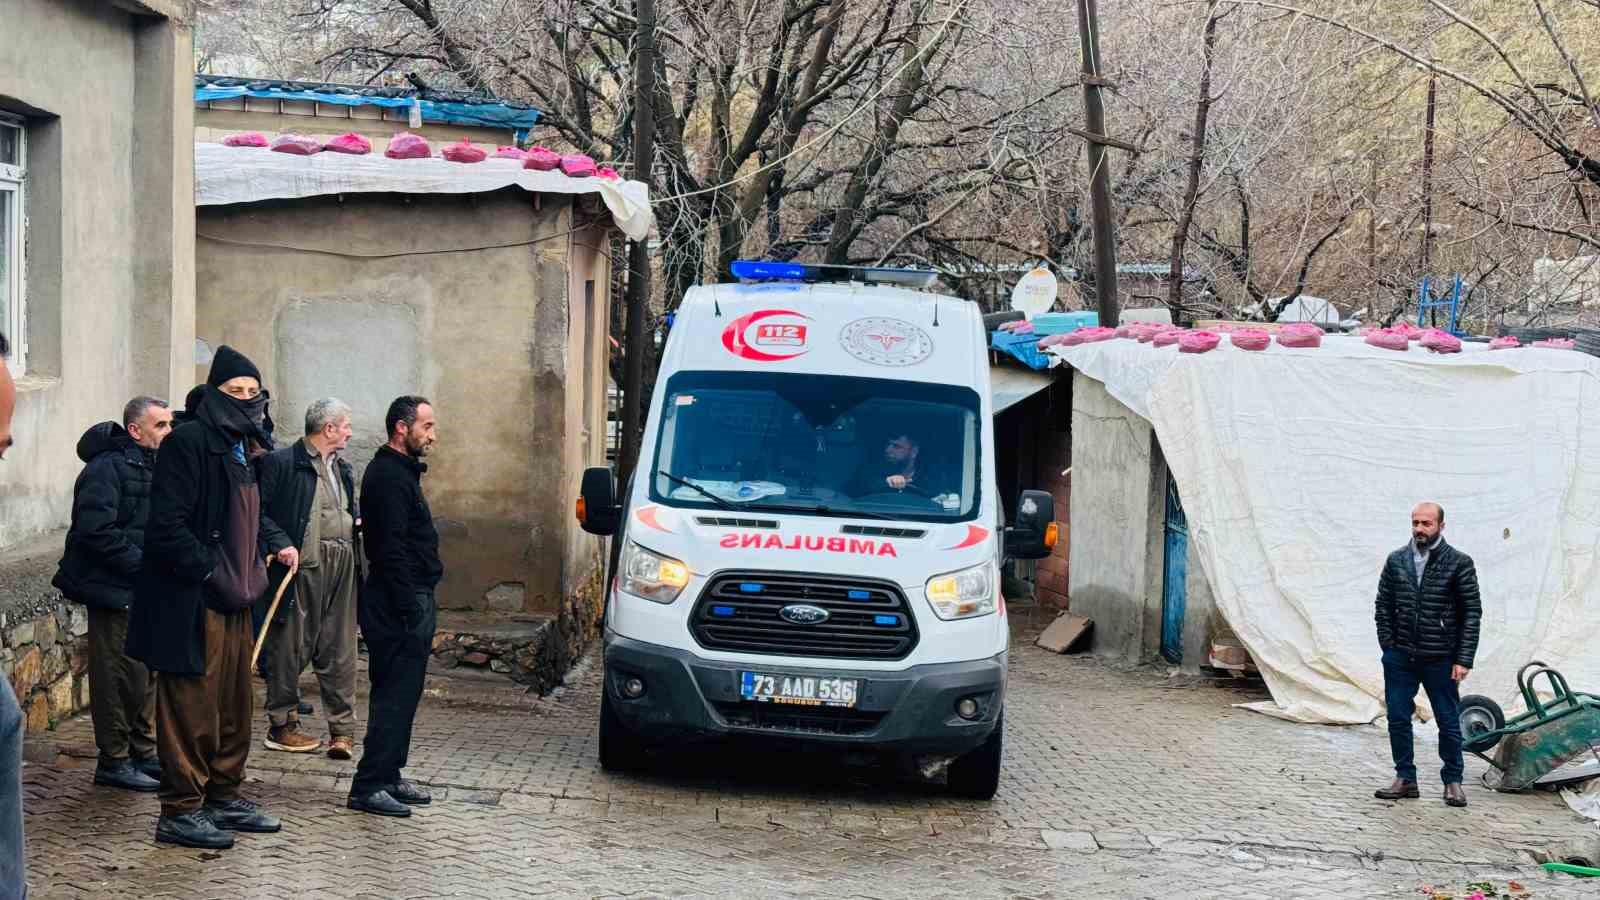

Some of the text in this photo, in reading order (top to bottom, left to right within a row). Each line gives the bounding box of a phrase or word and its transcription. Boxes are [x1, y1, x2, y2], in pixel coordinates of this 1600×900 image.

[764, 326, 799, 337] 112
[753, 675, 852, 701] 73 AAD 536
